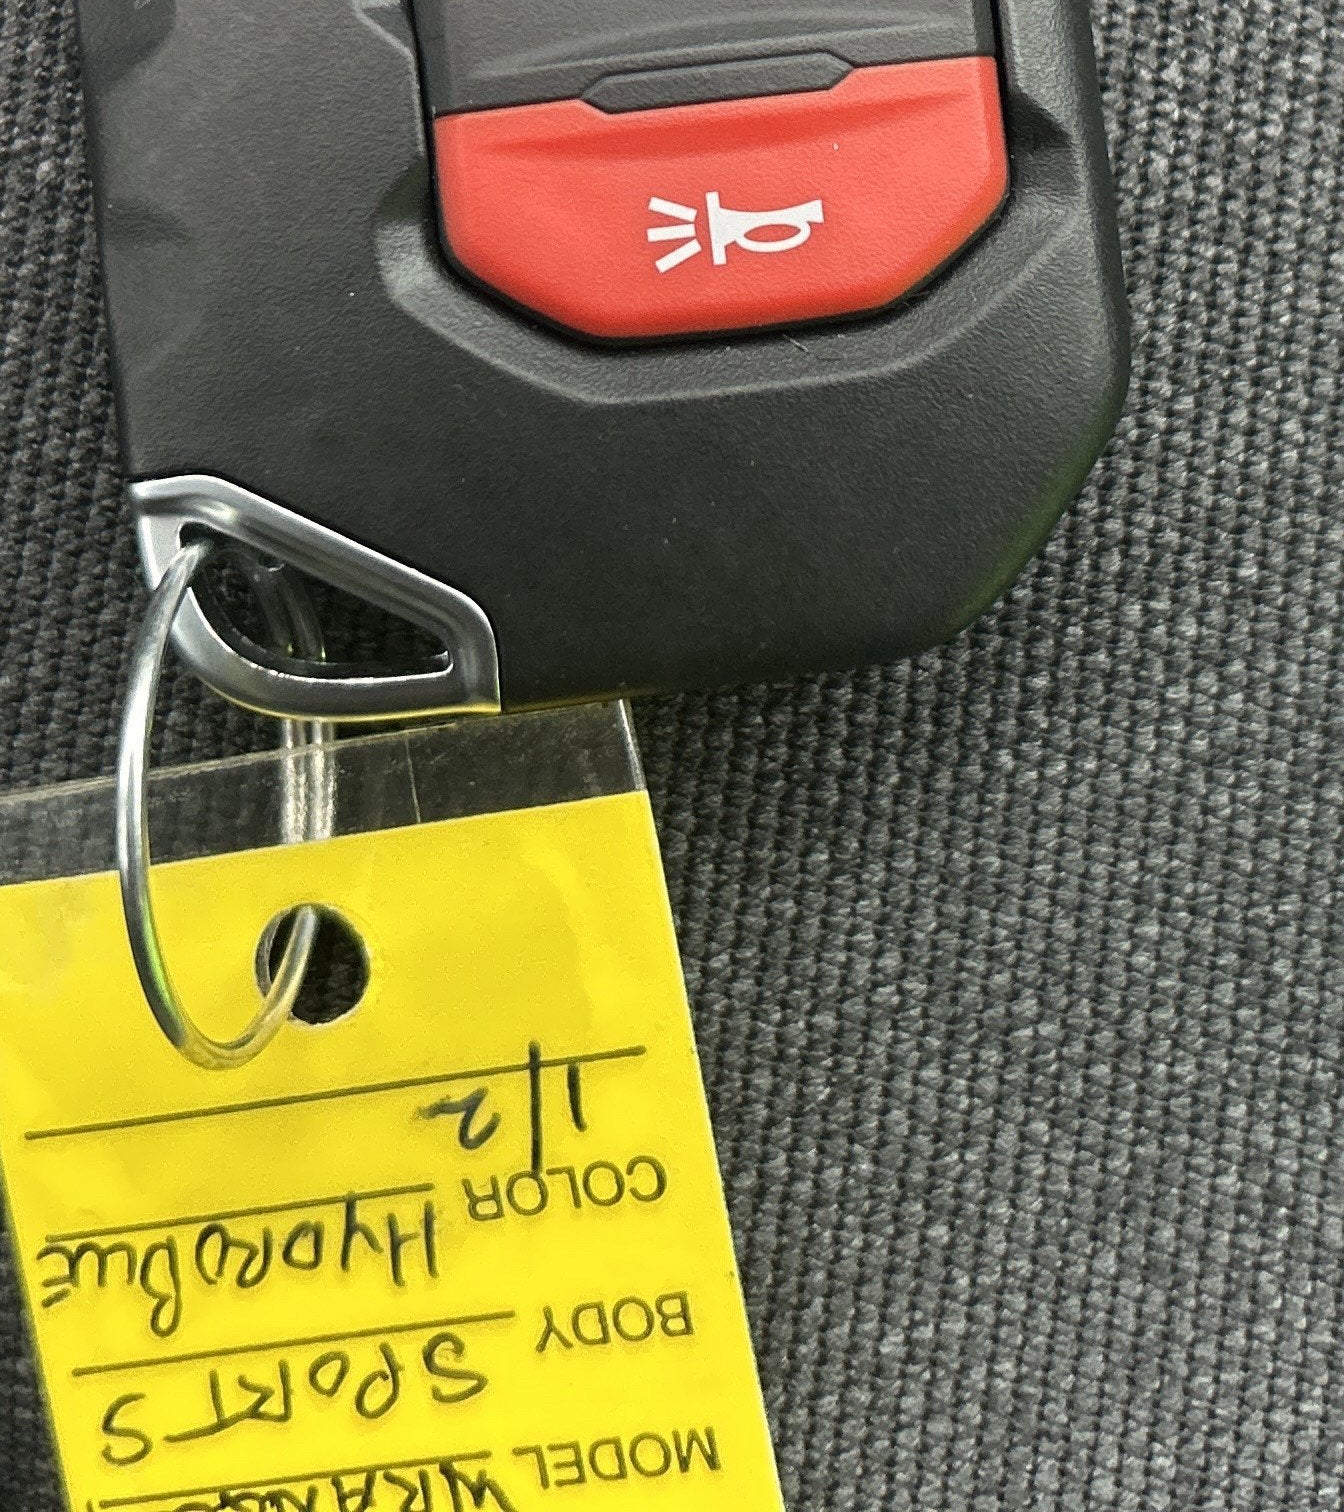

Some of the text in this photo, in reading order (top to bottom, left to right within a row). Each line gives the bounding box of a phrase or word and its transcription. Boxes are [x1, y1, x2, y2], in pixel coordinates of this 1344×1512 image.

[415, 1041, 585, 1173] 1/2
[463, 1155, 668, 1222] COLOR
[536, 1291, 694, 1354] BODY
[513, 1427, 722, 1486] MODEL
